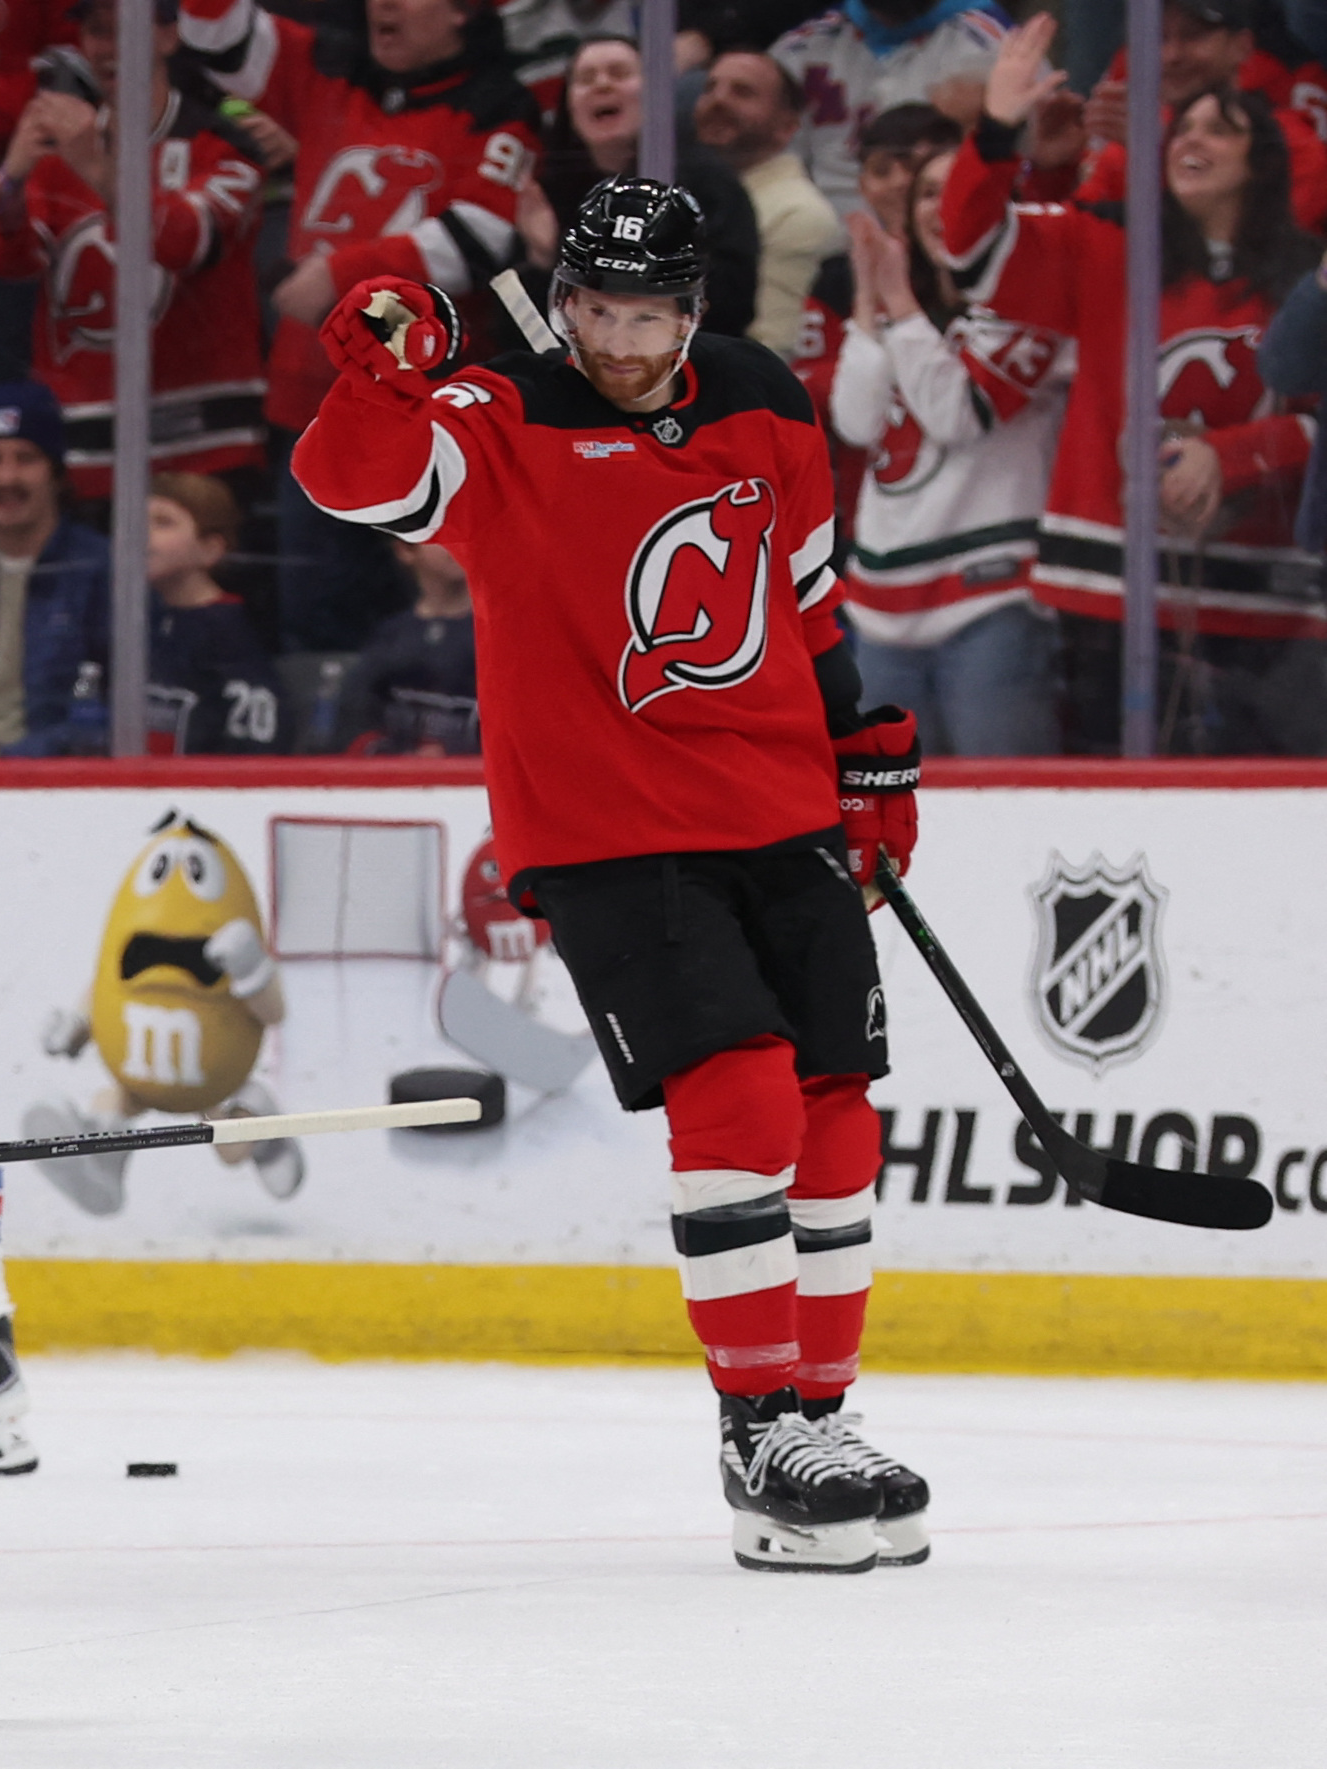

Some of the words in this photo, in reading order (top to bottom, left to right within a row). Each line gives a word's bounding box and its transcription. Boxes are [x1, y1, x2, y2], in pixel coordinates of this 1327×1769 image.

[612, 215, 645, 242] 16
[594, 257, 648, 272] CCM
[224, 679, 278, 743] 20
[1057, 912, 1144, 1024] NHL
[122, 1003, 206, 1086] m
